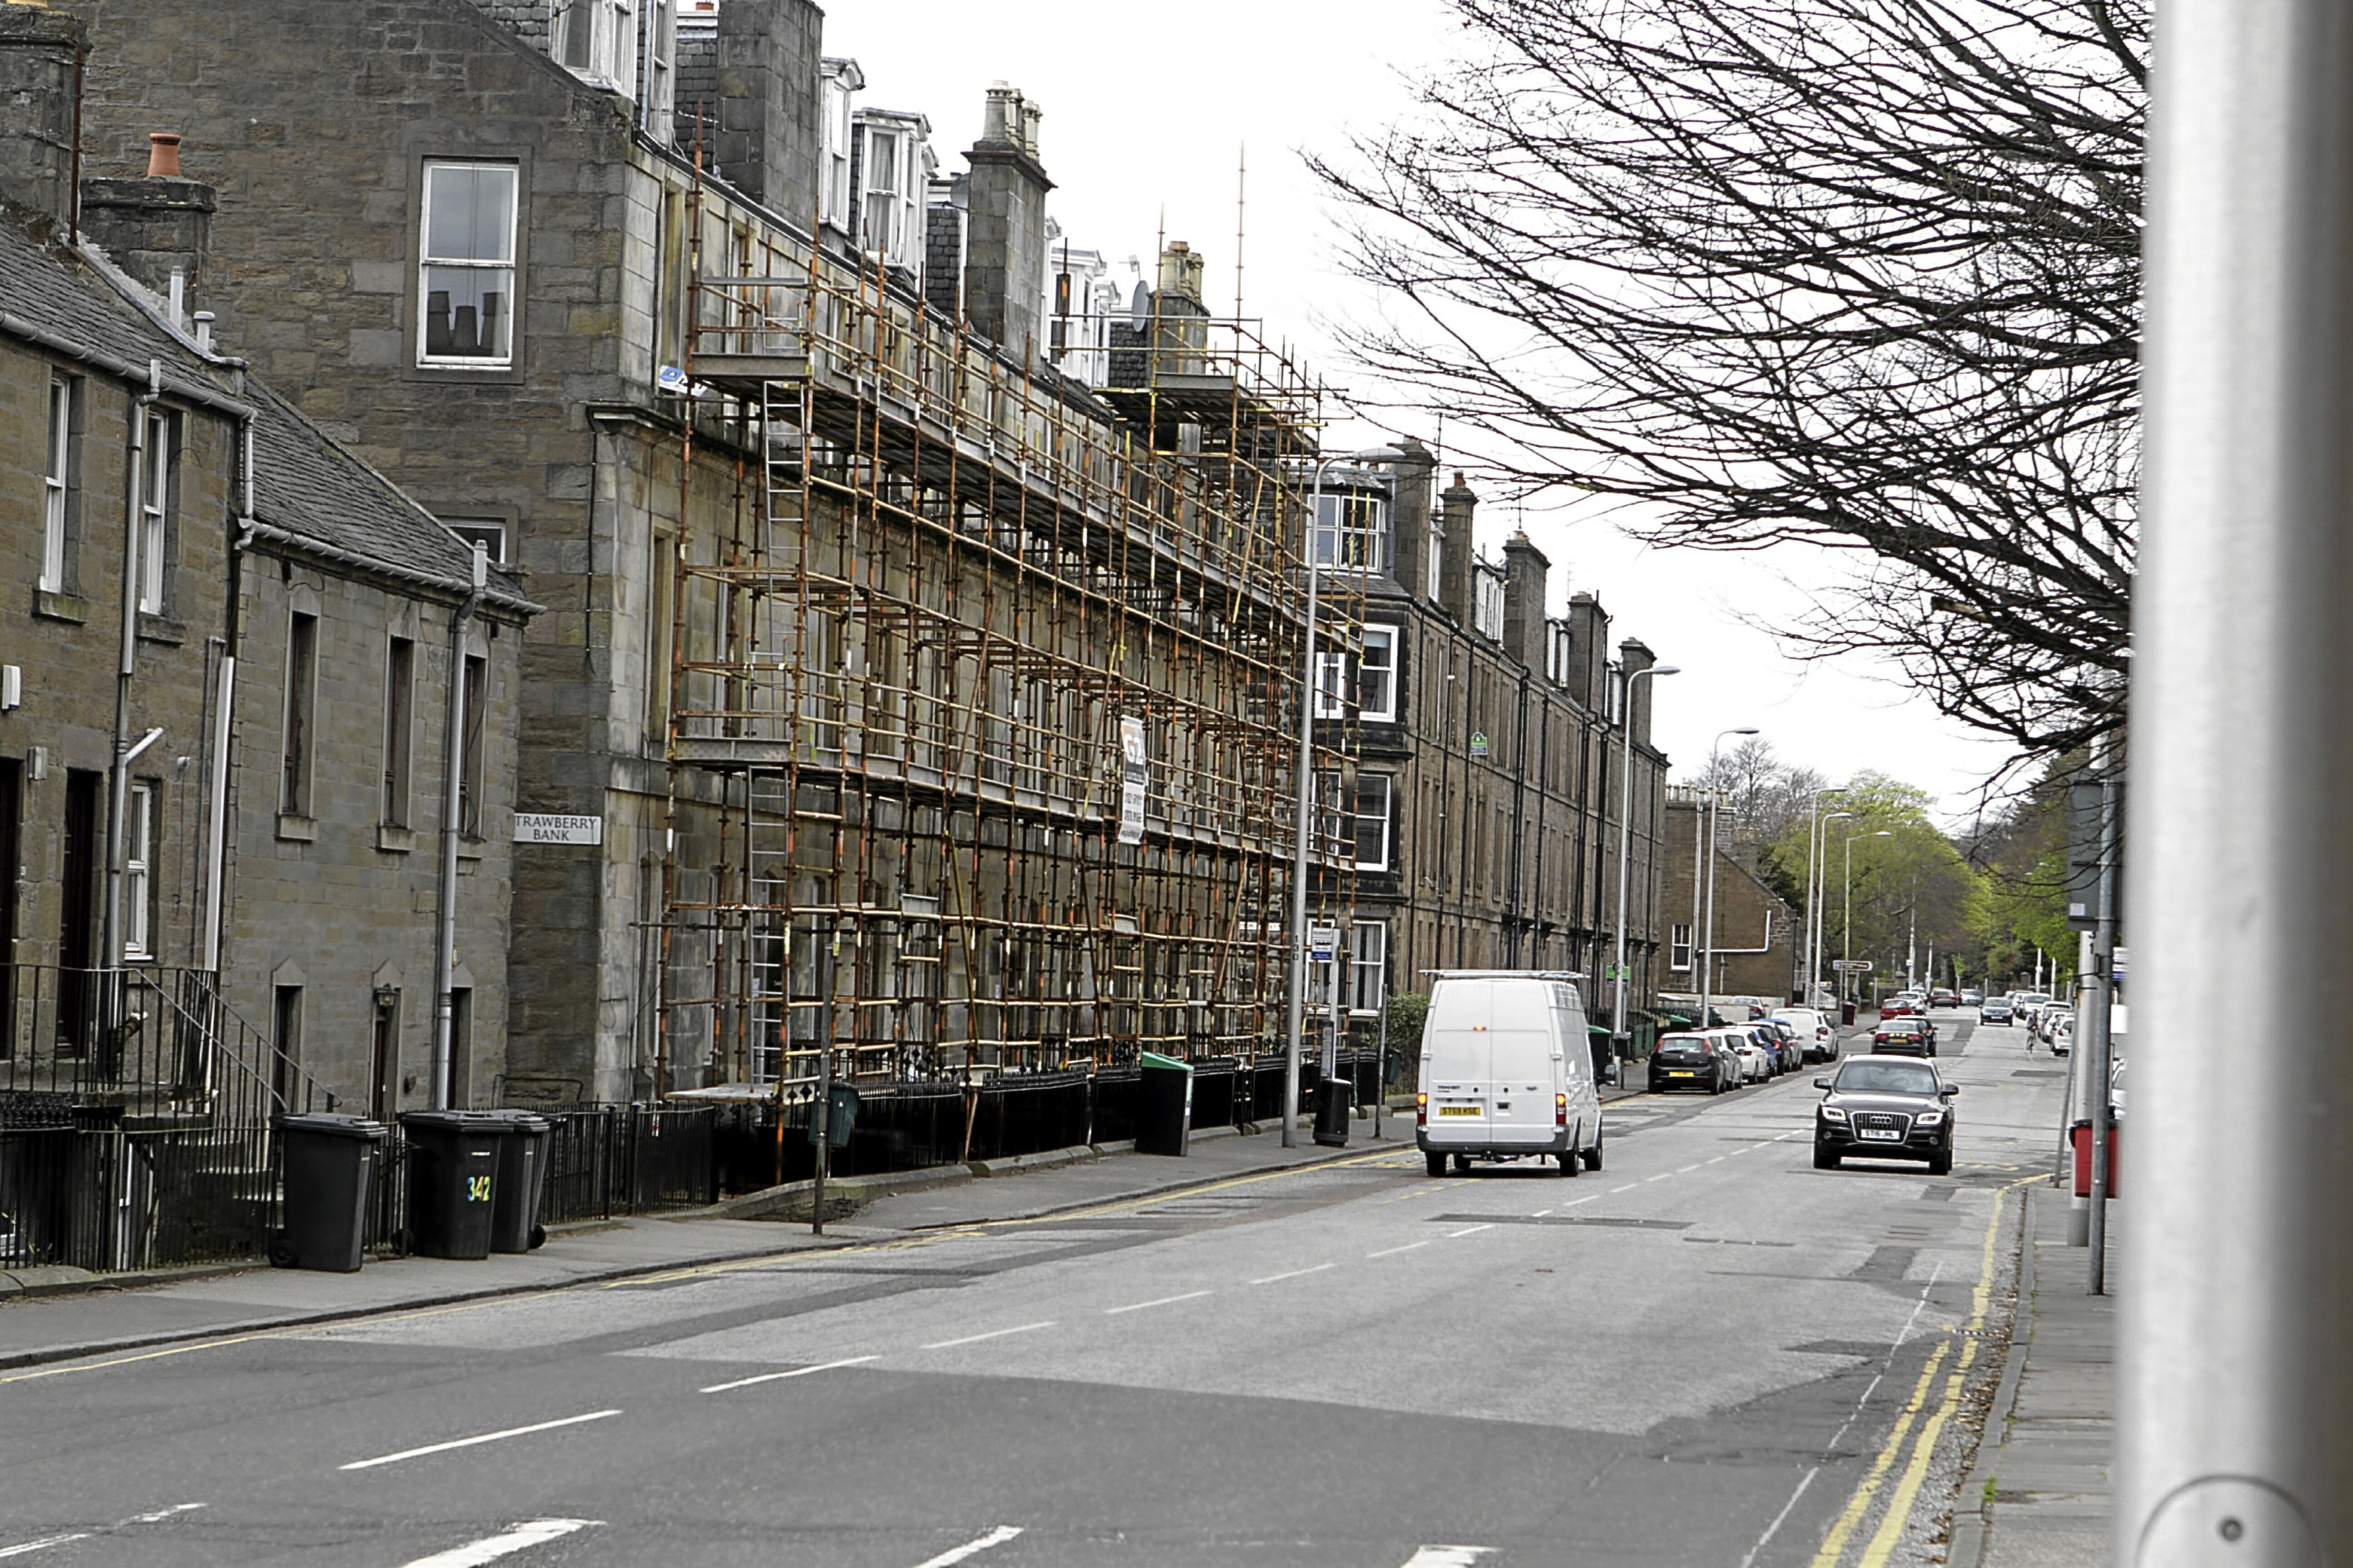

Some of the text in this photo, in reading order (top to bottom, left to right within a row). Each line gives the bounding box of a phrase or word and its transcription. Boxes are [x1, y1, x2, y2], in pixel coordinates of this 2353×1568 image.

[1124, 734, 1144, 766] G2
[515, 816, 596, 829] TRAWBERRY
[533, 829, 569, 841] BANK
[467, 1176, 490, 1201] 342
